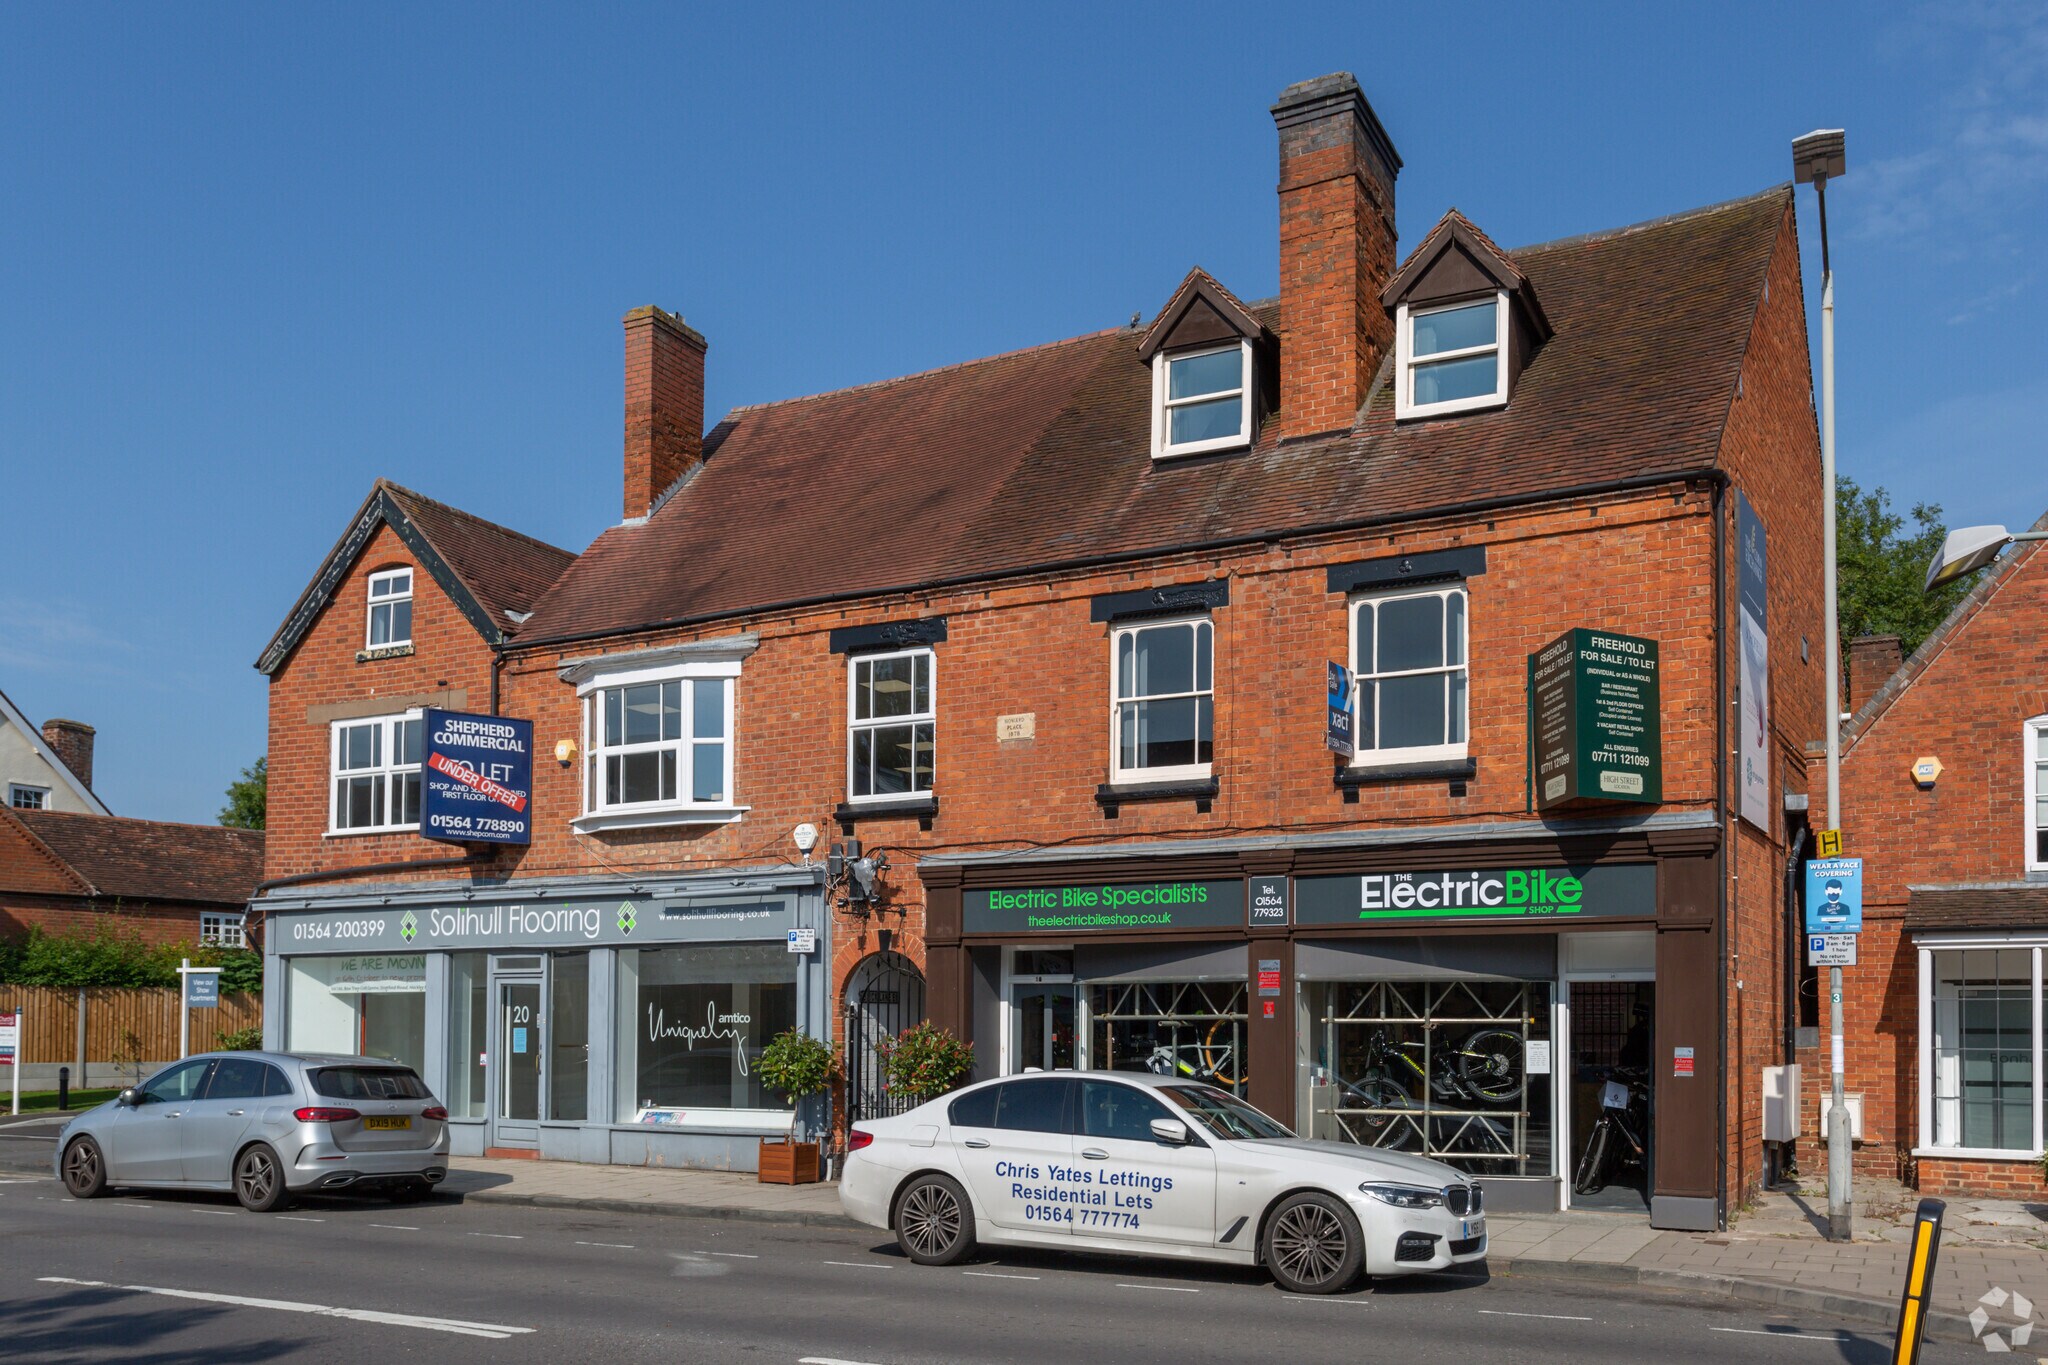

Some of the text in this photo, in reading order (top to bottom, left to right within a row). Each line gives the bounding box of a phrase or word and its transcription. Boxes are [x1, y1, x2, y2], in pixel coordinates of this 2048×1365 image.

[1540, 640, 1567, 664] FREEHOLD
[1592, 637, 1645, 654] FREEHOLD
[1535, 669, 1543, 681] FOR
[1544, 663, 1554, 677] SALE
[1558, 658, 1564, 669] TO
[1564, 652, 1573, 665] LET
[1581, 651, 1655, 669] FOR SALE / TO LET
[1587, 668, 1615, 677] (INDIVIDUAL
[1633, 674, 1650, 682] WHOLE)
[445, 720, 514, 738] SHEPHERD
[434, 732, 525, 752] COMMERCIAL
[1613, 744, 1638, 752] ENQUIRIES
[1541, 753, 1569, 774] 07711 121099
[1592, 751, 1649, 766] 07711 121099
[481, 762, 513, 782] LET
[1604, 772, 1639, 786] HIGH STREET
[430, 782, 449, 791] SHOP
[438, 758, 518, 806] UNDER OFFER
[431, 815, 524, 832] 01564 778890
[446, 829, 510, 838] www.shepcom.com
[1822, 832, 1838, 854] H
[1394, 873, 1412, 881] THE
[989, 883, 1207, 910] Electric Bike Specialists
[1262, 886, 1276, 895] Tel.
[1361, 870, 1583, 908] Electric Bike
[1255, 896, 1282, 906] 01564
[1528, 905, 1554, 914] SHOP
[430, 902, 600, 938] Solihull Flooring
[659, 907, 770, 921] www.solihullflooring.co.uk
[1027, 912, 1172, 927] theelectricbikeshop.co.uk
[1254, 908, 1284, 918] 779323
[294, 920, 385, 939] 01564 200399
[1814, 940, 1822, 950] P
[341, 956, 426, 971] WE ARE MOVIN
[1833, 994, 1840, 1003] 3
[513, 1006, 529, 1023] 20
[718, 1012, 750, 1023] amtico
[648, 1001, 748, 1076] Uniquely
[996, 1161, 1173, 1192] Chris Yates Lettings
[1012, 1183, 1153, 1209] Residential Lets
[1025, 1205, 1140, 1229] 01564 777774
